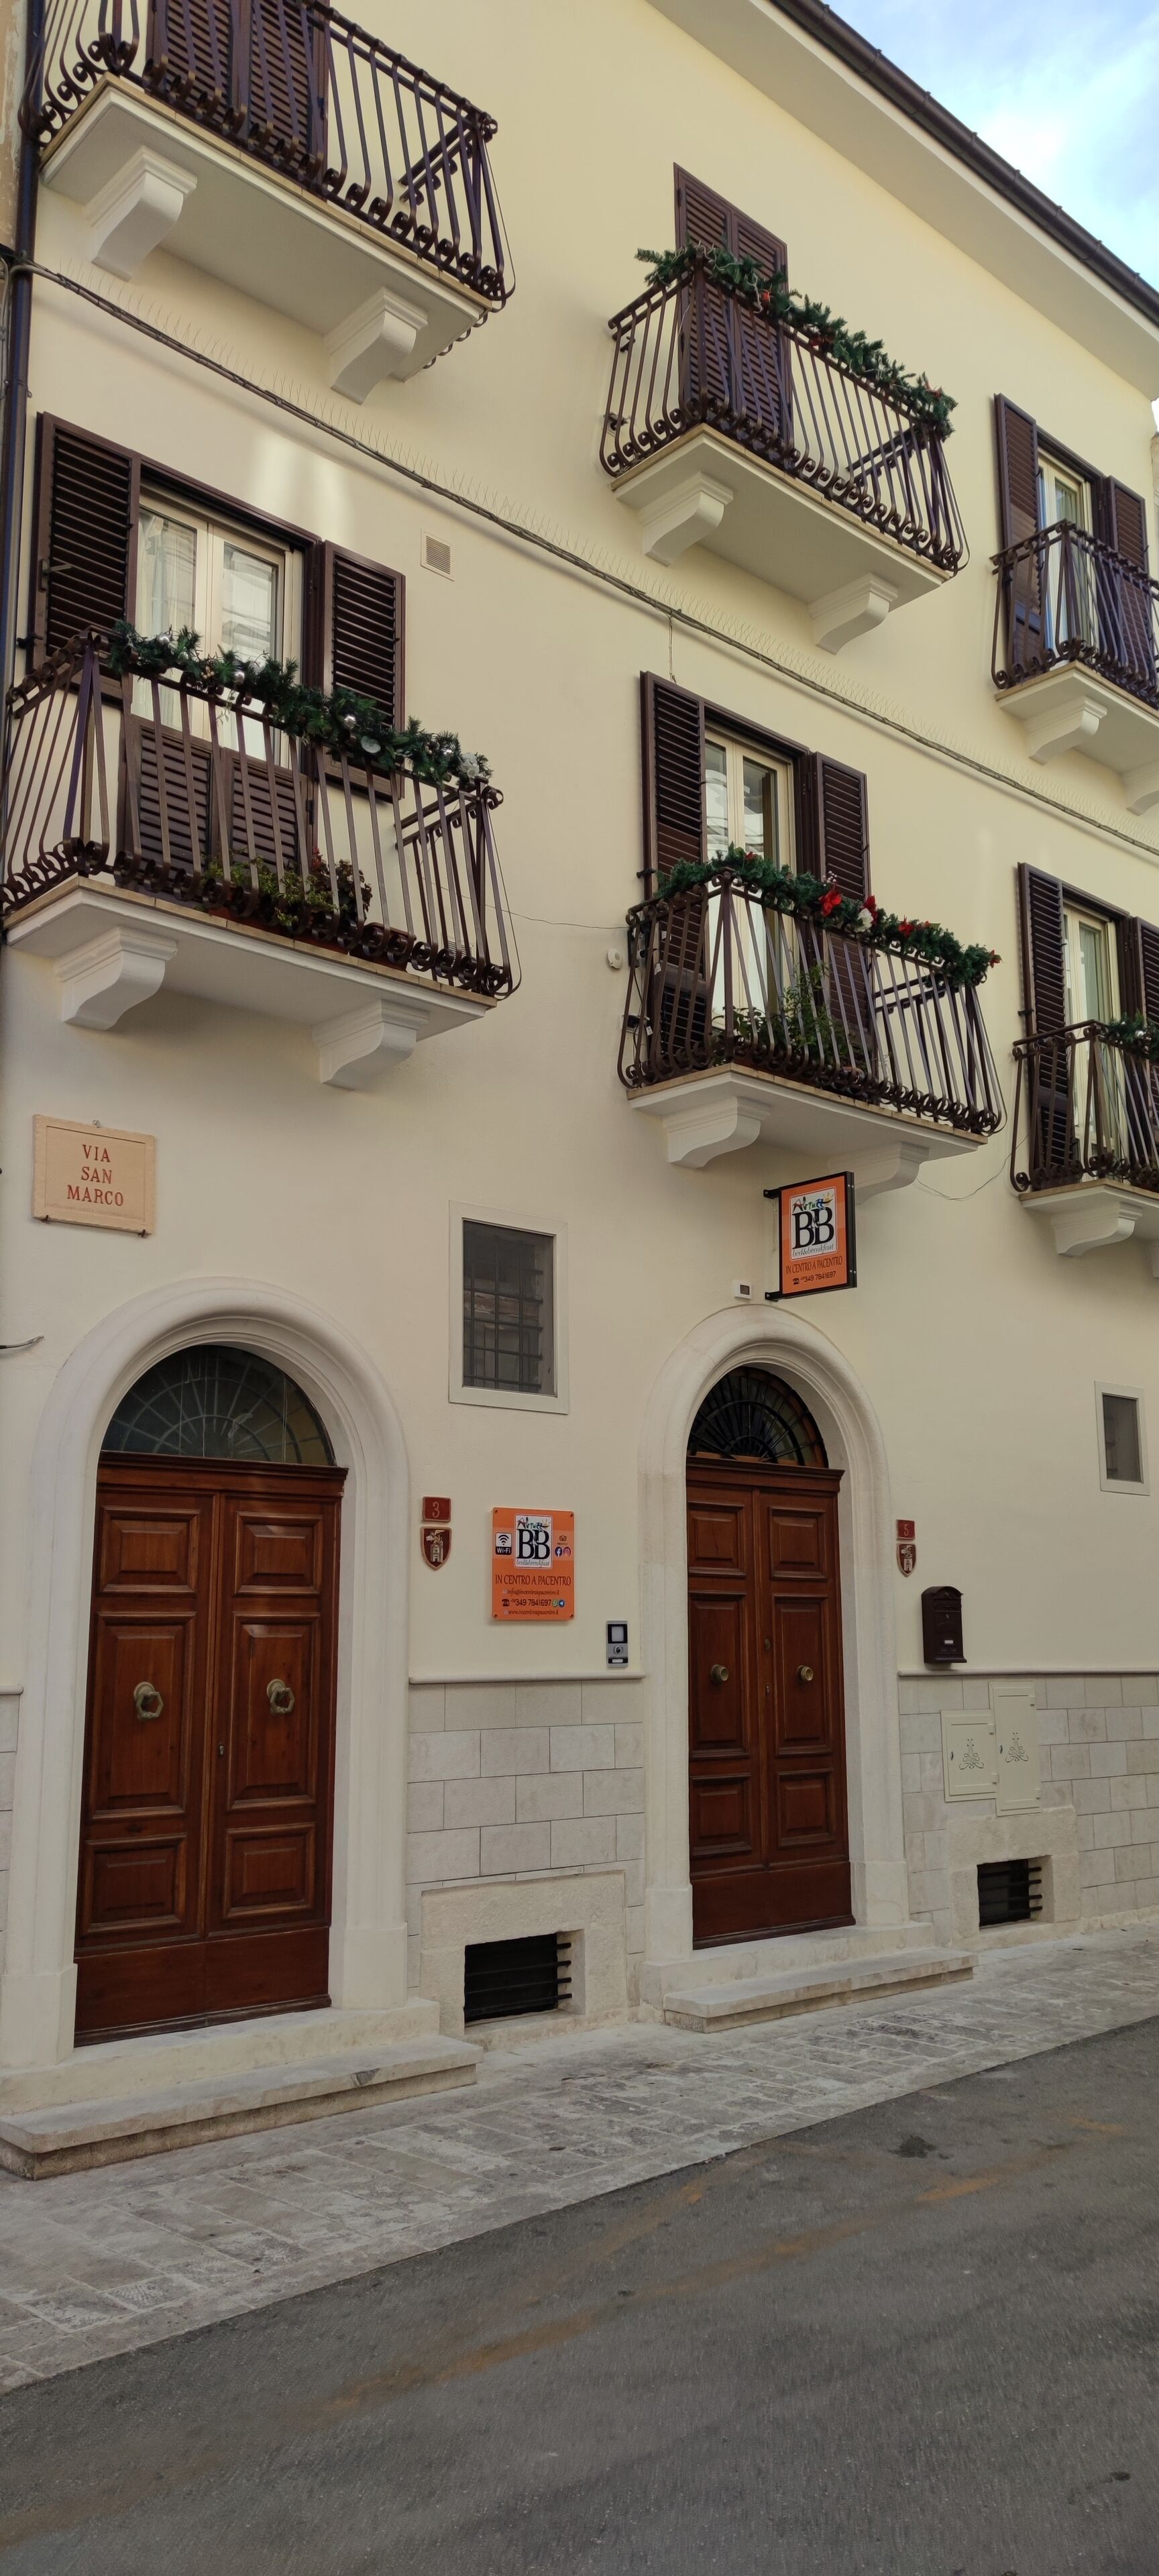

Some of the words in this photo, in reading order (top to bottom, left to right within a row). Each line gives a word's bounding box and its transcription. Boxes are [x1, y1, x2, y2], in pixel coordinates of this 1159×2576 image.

[82, 1144, 111, 1163] VIA
[80, 1166, 113, 1184] SAN
[66, 1184, 124, 1206] MARCO
[792, 1244, 834, 1257] bed&breakfast
[785, 1265, 791, 1275] IN
[792, 1261, 811, 1273] CENTRO
[817, 1255, 843, 1269] PACENTRO
[432, 1501, 440, 1518] 3
[903, 1523, 909, 1536] 5
[495, 1574, 502, 1585] IN
[504, 1574, 531, 1585] CENTRO
[531, 1576, 537, 1585] A
[538, 1575, 571, 1586] PACENTRO
